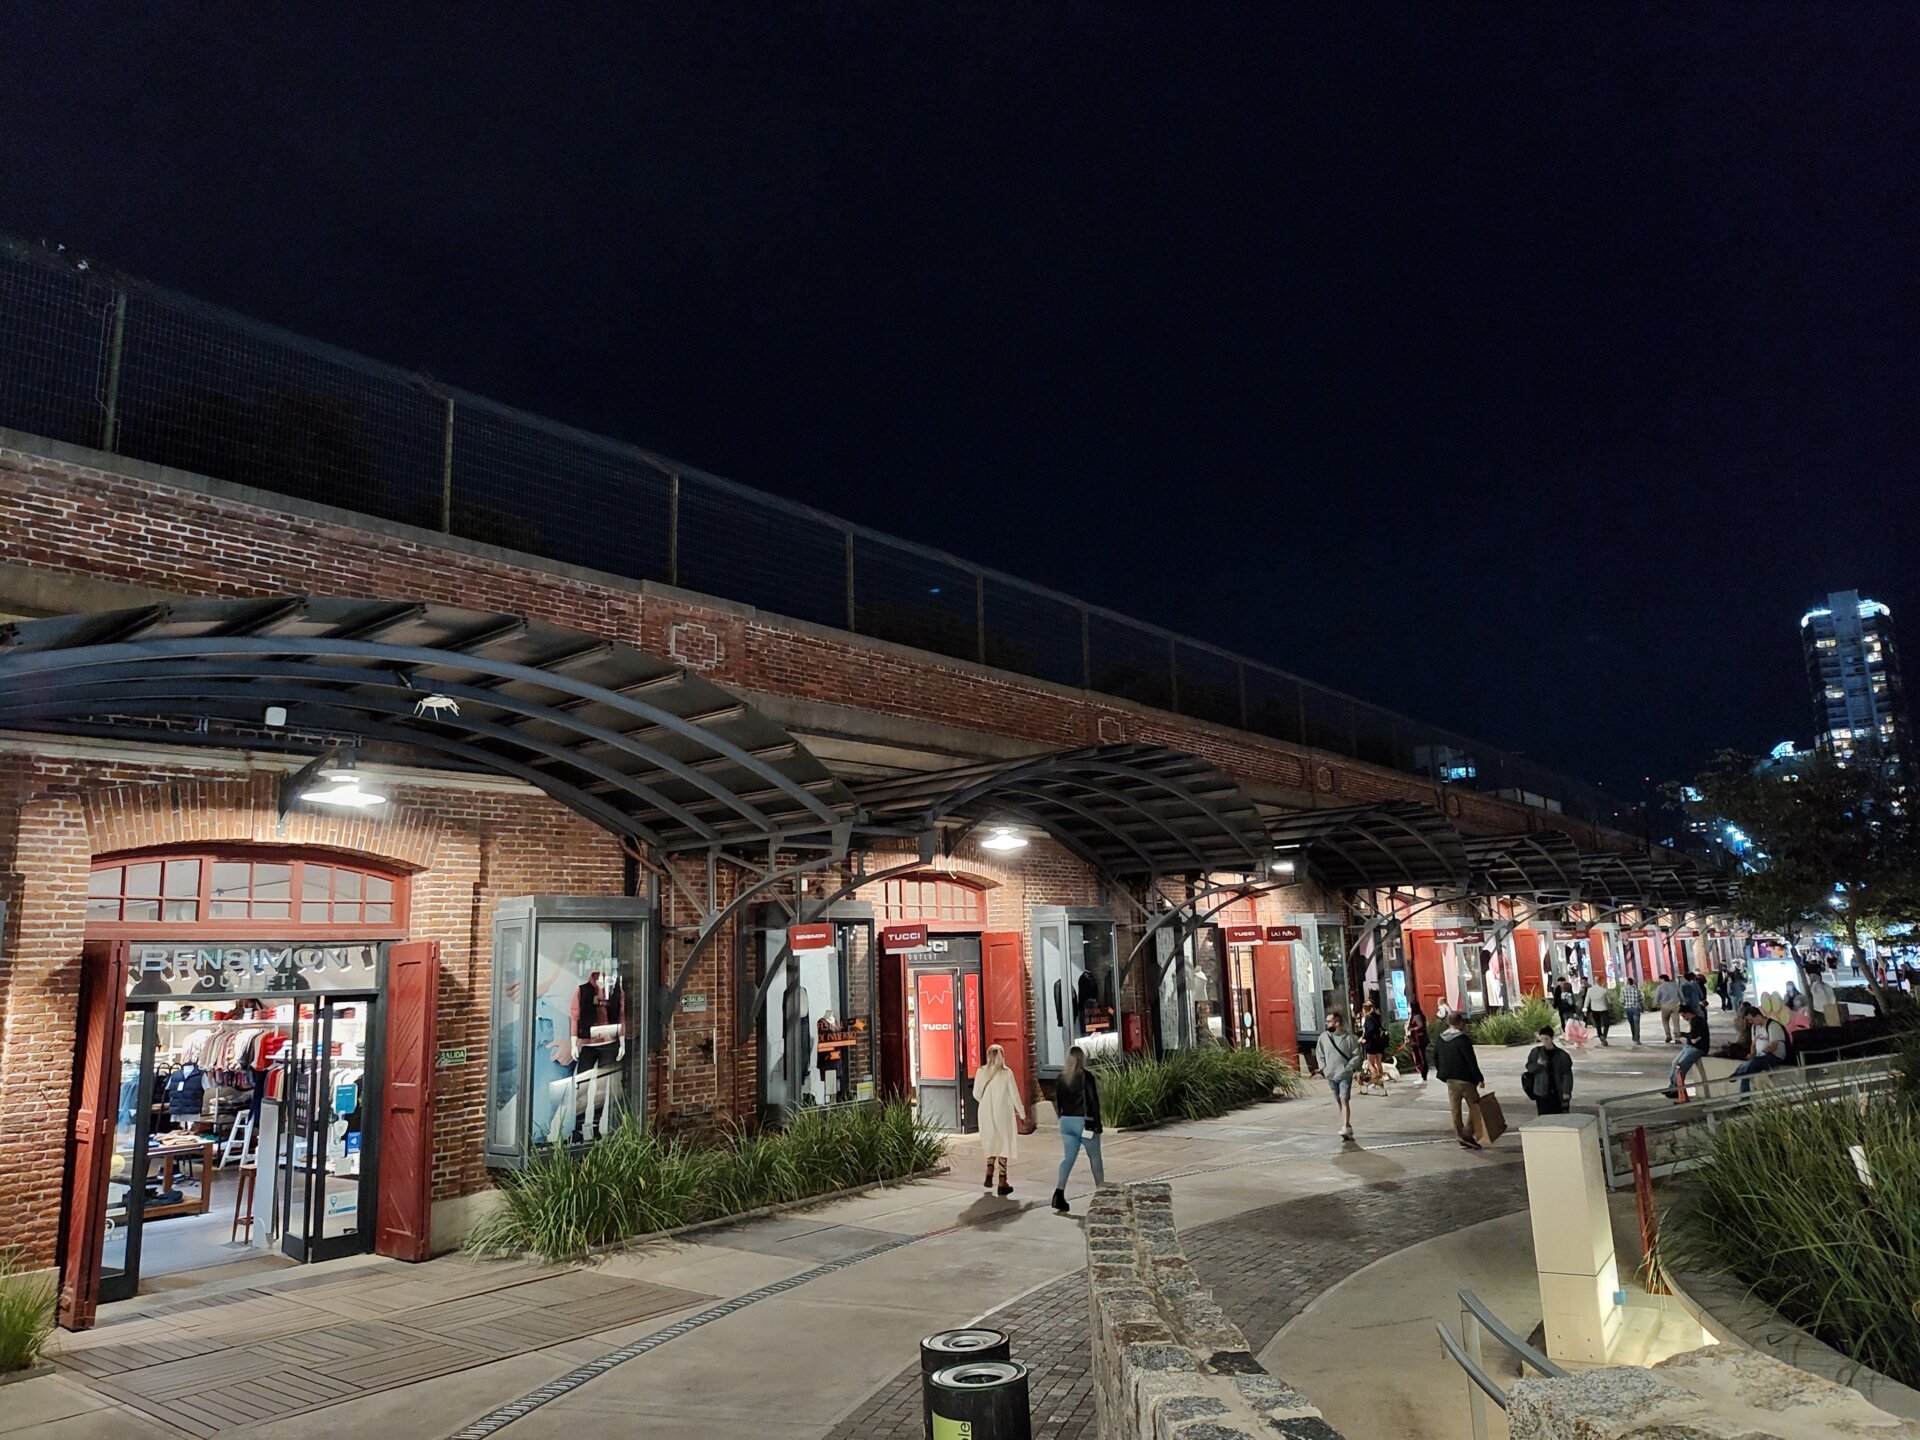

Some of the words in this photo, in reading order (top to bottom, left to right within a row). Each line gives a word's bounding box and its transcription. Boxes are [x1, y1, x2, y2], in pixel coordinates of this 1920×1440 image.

[888, 933, 921, 941] TUCCI
[140, 948, 348, 972] BENSIMON
[908, 953, 937, 961] OUTLET
[441, 1050, 465, 1059] SALIDA
[957, 1422, 971, 1440] le
